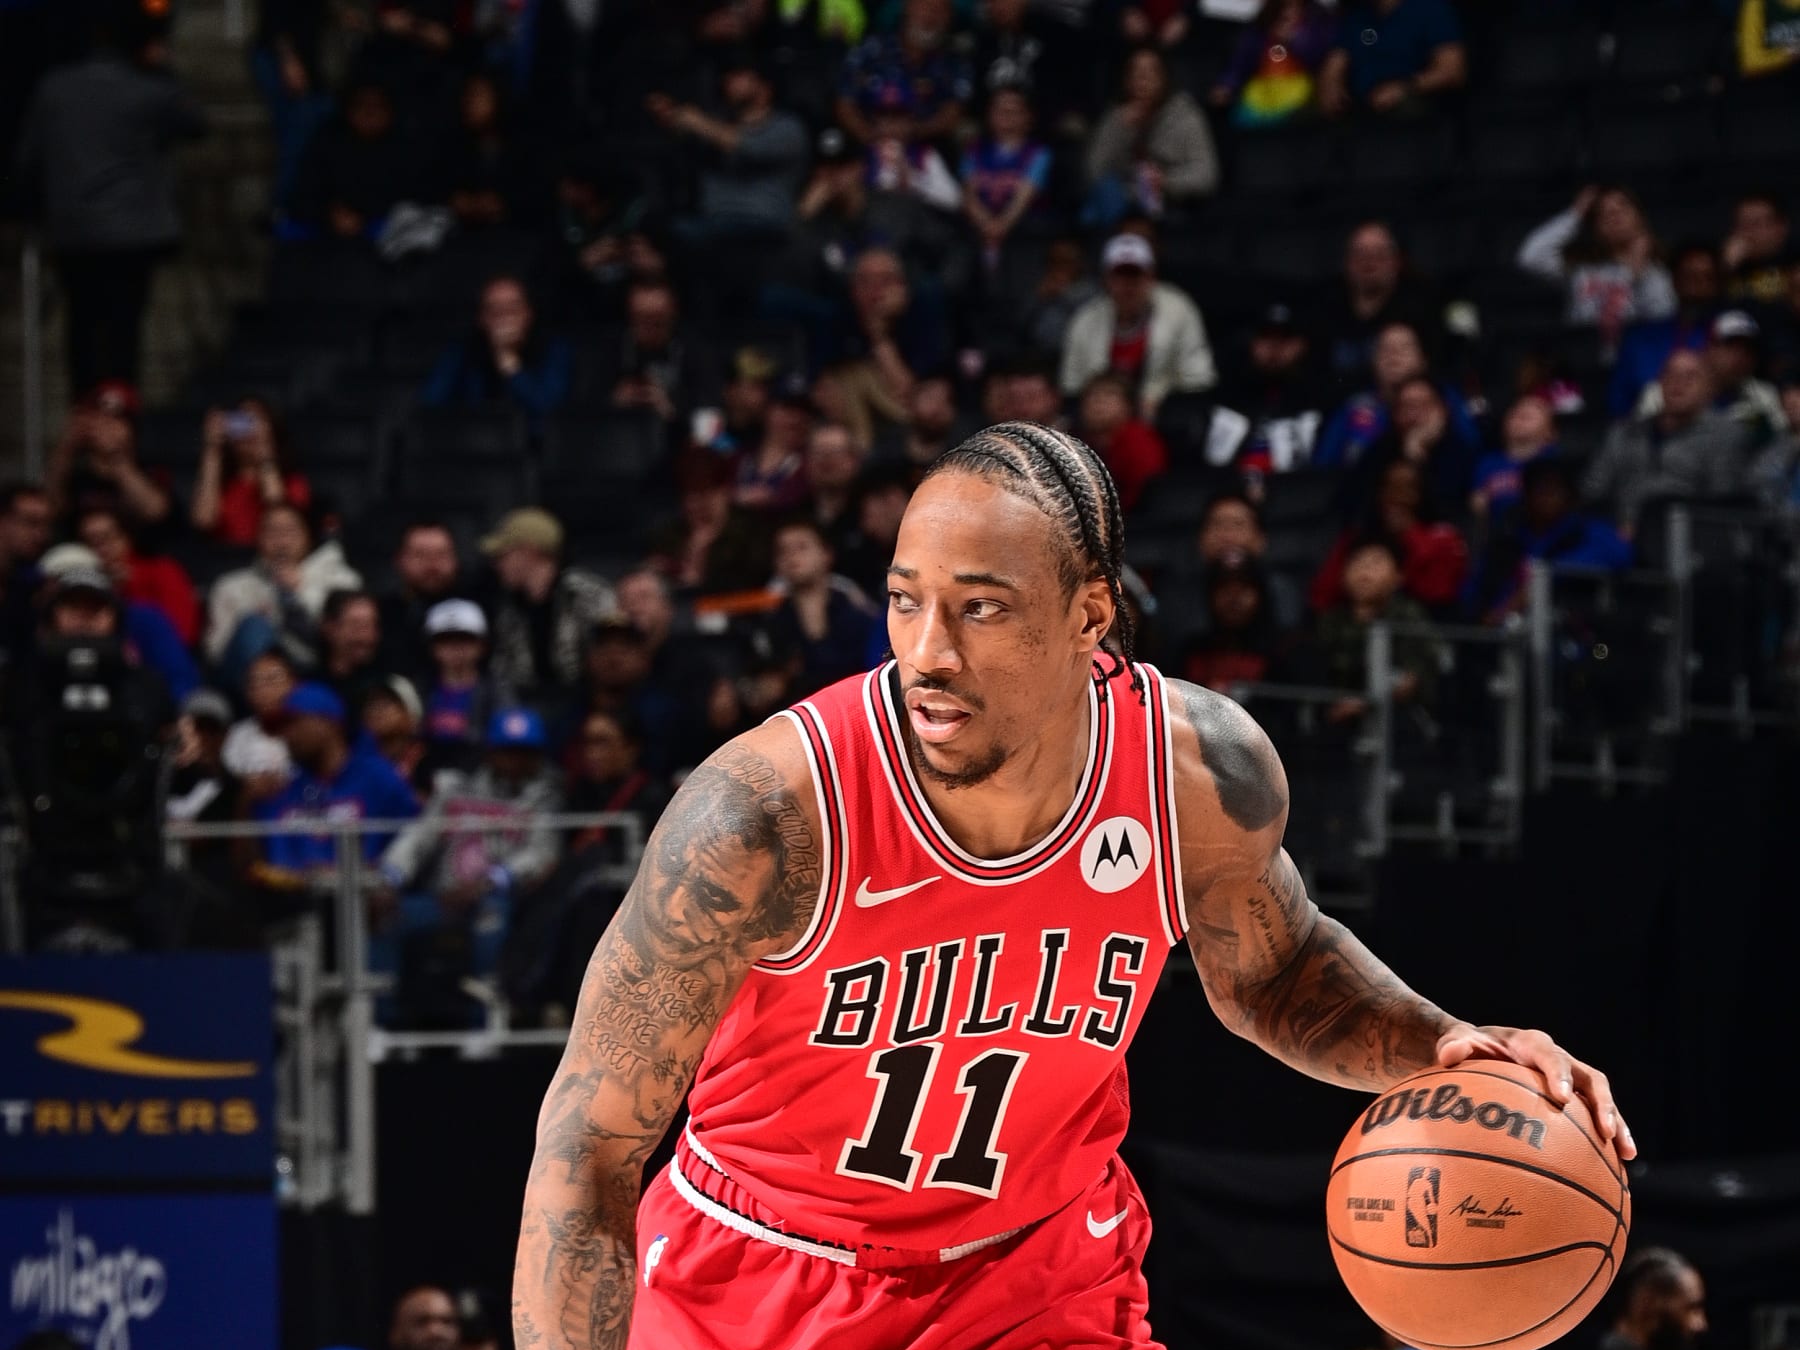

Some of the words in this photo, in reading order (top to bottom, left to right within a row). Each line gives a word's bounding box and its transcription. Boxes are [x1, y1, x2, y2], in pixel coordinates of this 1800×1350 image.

[808, 928, 1149, 1051] BULLS
[835, 1042, 1029, 1199] 11
[1361, 1083, 1547, 1151] Wilson
